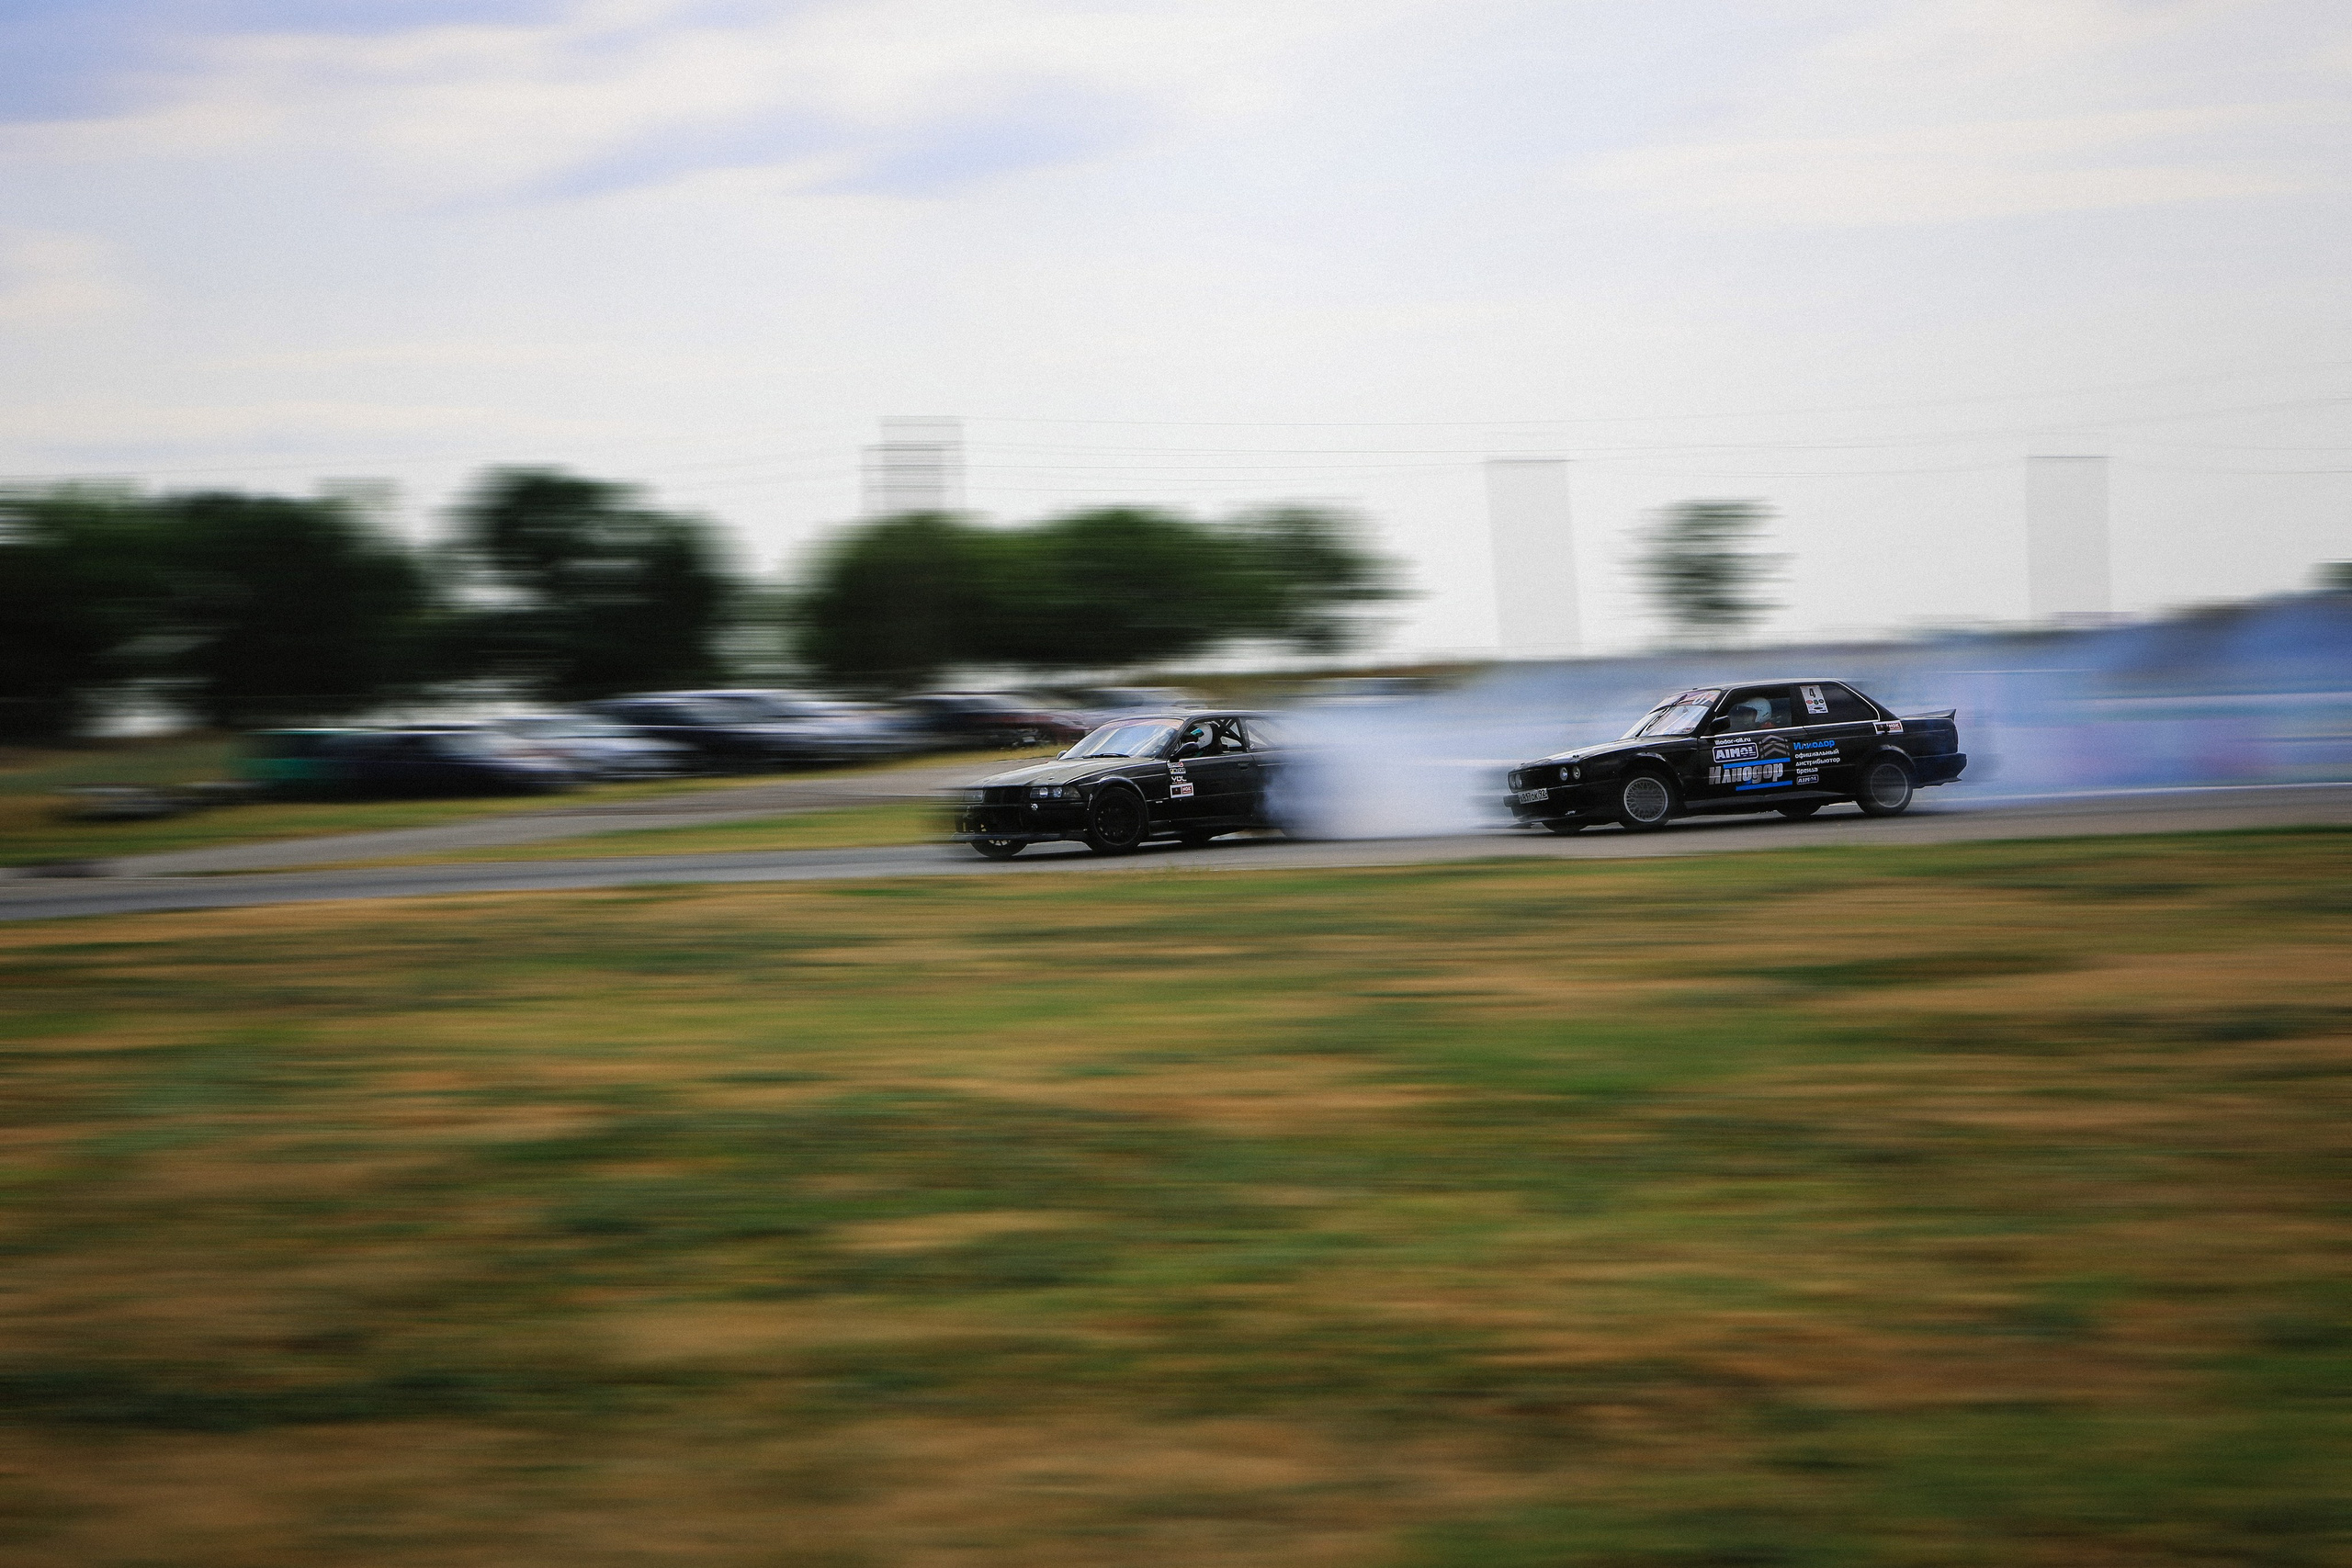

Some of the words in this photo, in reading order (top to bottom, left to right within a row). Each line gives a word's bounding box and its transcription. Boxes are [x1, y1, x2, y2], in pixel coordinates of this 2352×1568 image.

[1793, 740, 1835, 750] Илиодор
[1716, 746, 1756, 760] AIMOL
[1795, 749, 1839, 759] официальный
[1795, 758, 1840, 766] дистрибьютор
